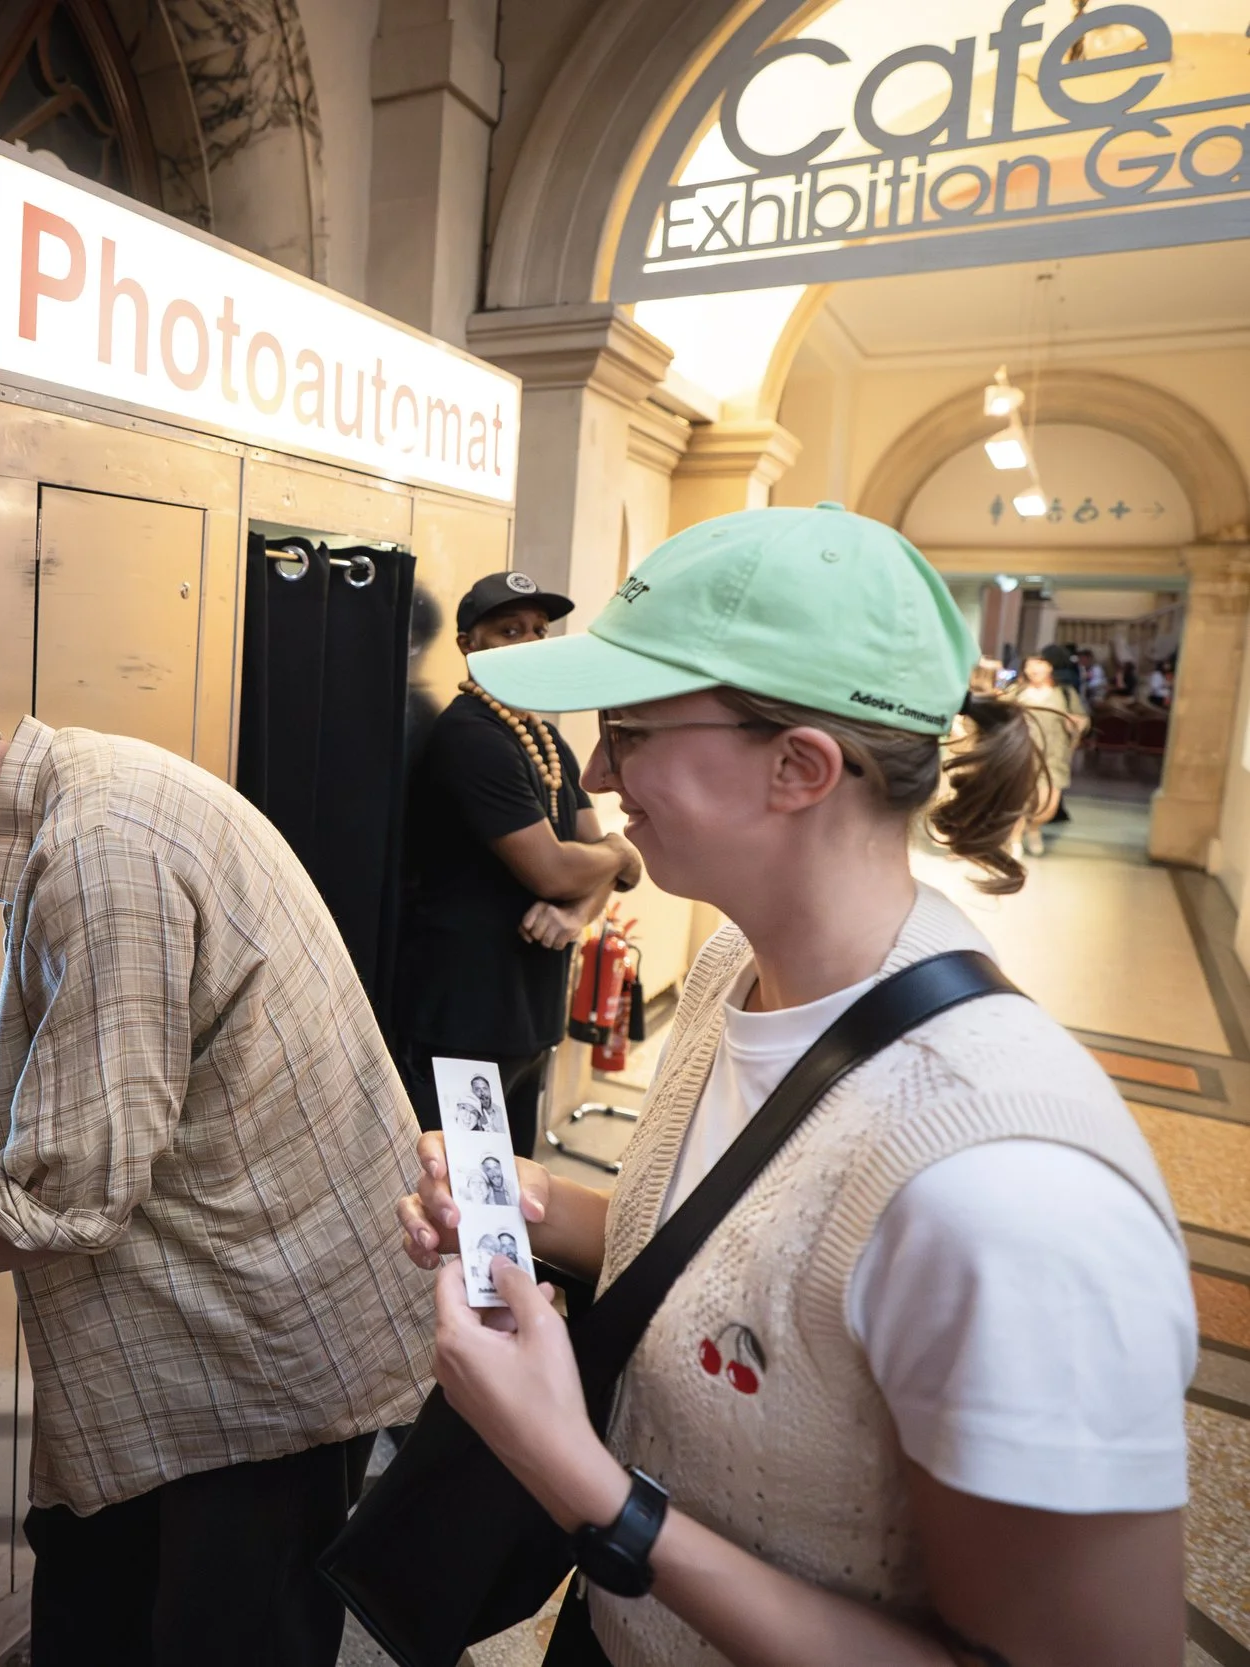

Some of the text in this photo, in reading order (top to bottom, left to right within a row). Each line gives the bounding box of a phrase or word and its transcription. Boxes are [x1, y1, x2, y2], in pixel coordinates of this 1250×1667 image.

[661, 153, 1052, 258] Exhibition
[18, 201, 503, 478] Photoautomat
[850, 690, 894, 711] Adobe
